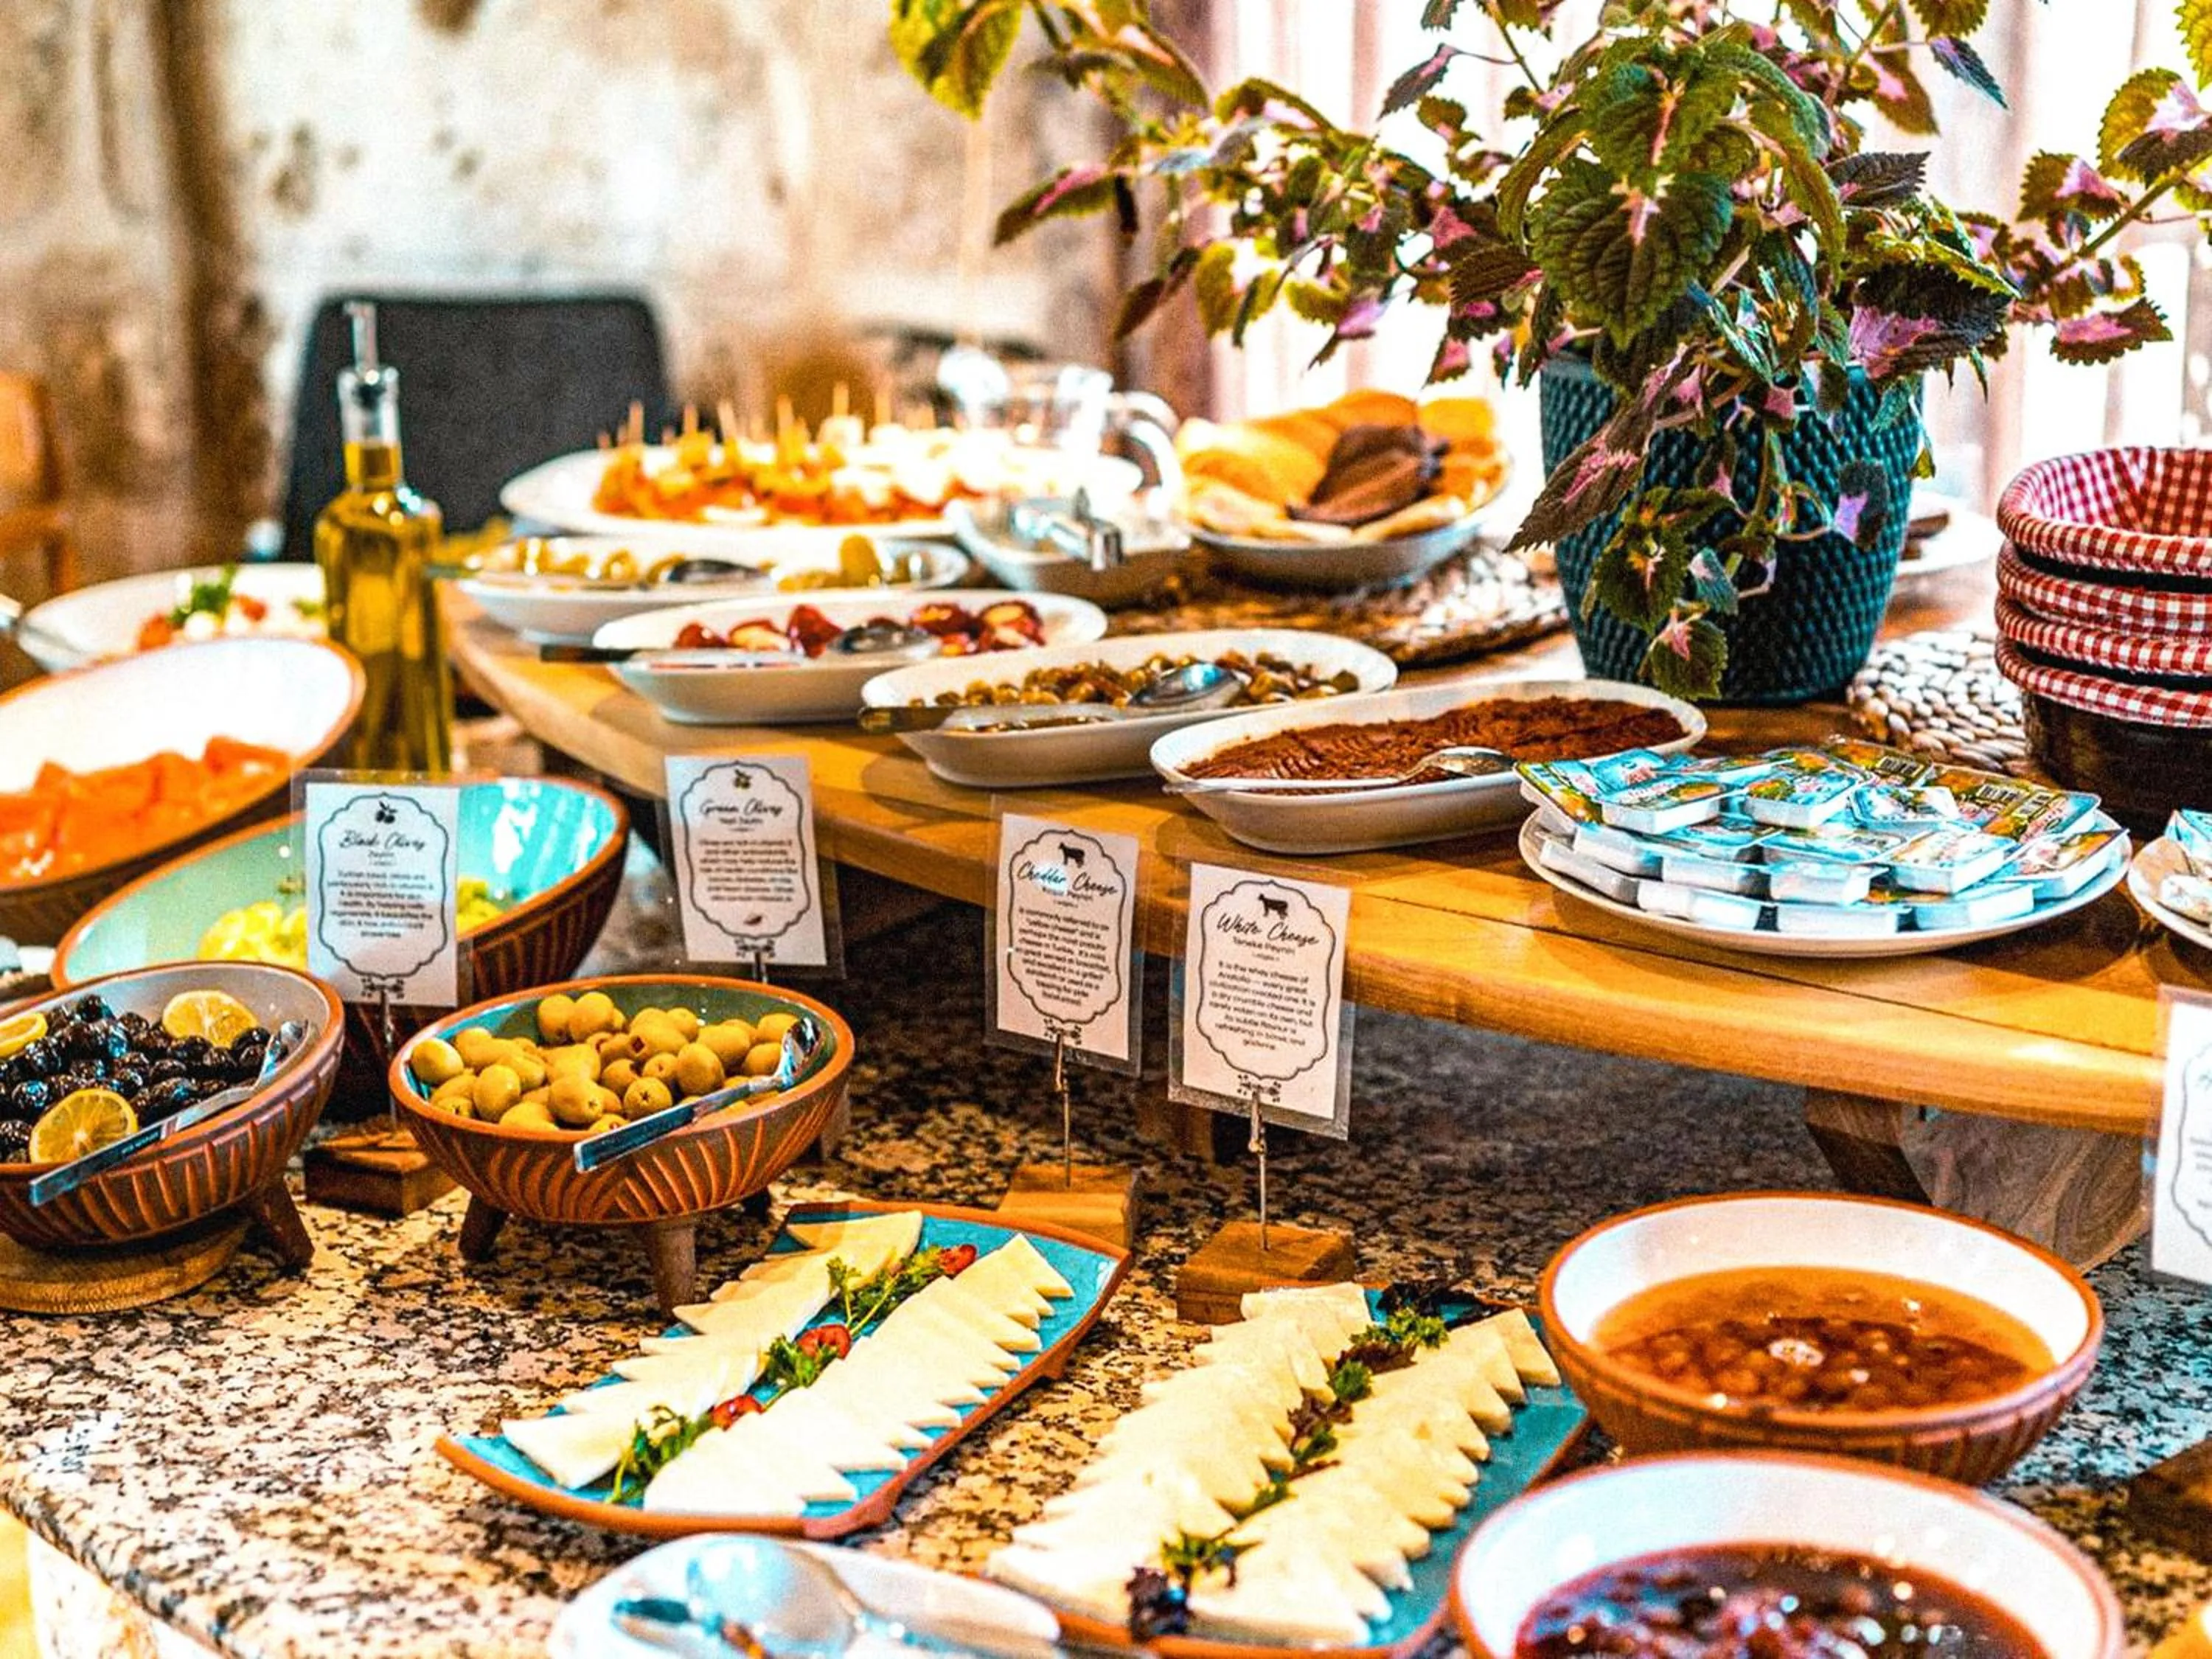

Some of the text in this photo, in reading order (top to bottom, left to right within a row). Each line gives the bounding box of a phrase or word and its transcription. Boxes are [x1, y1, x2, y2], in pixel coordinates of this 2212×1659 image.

[699, 799, 739, 815] Green
[1017, 860, 1066, 884] Cheddar
[1217, 912, 1262, 934] White
